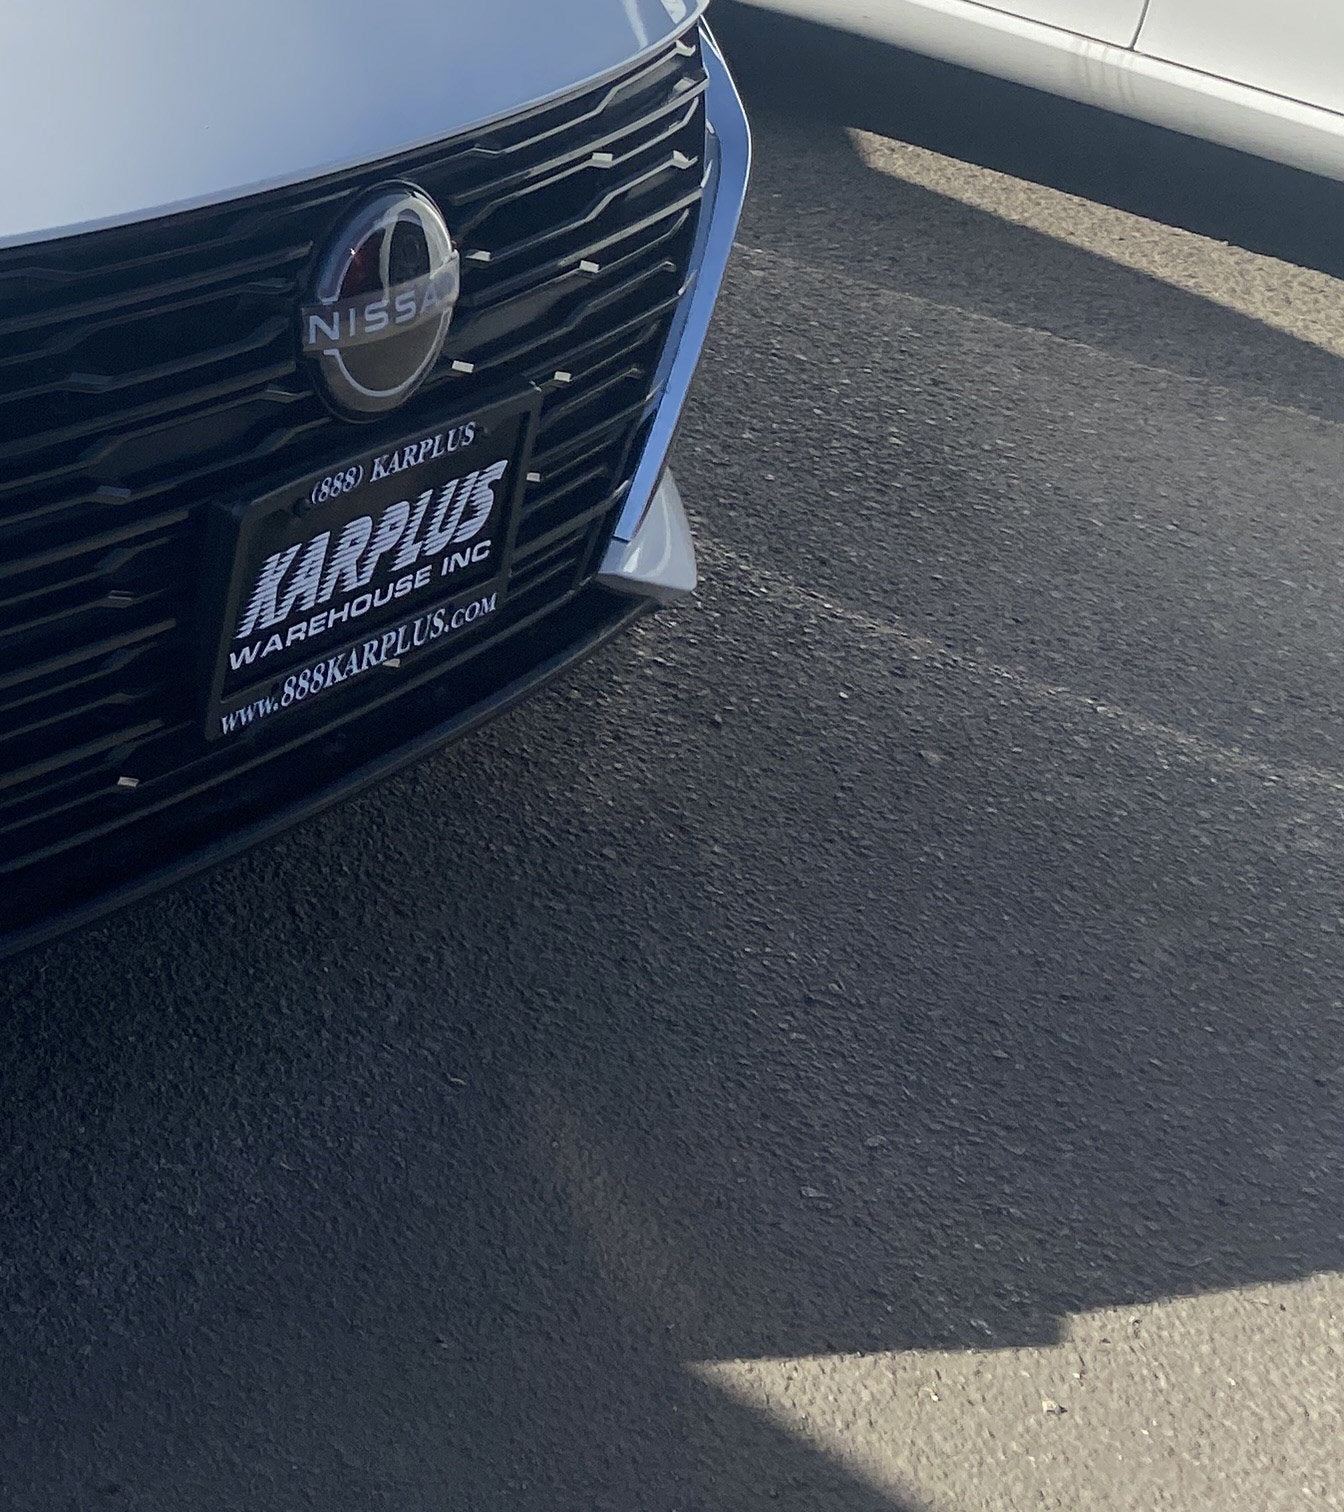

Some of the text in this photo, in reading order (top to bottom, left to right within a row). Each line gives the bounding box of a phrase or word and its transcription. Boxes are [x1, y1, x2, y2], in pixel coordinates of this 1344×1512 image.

[309, 272, 455, 344] NISSA
[311, 421, 476, 505] (888) KARPLUS
[234, 459, 509, 639] KARPLUS
[229, 540, 492, 670] WAREHOUSE INC
